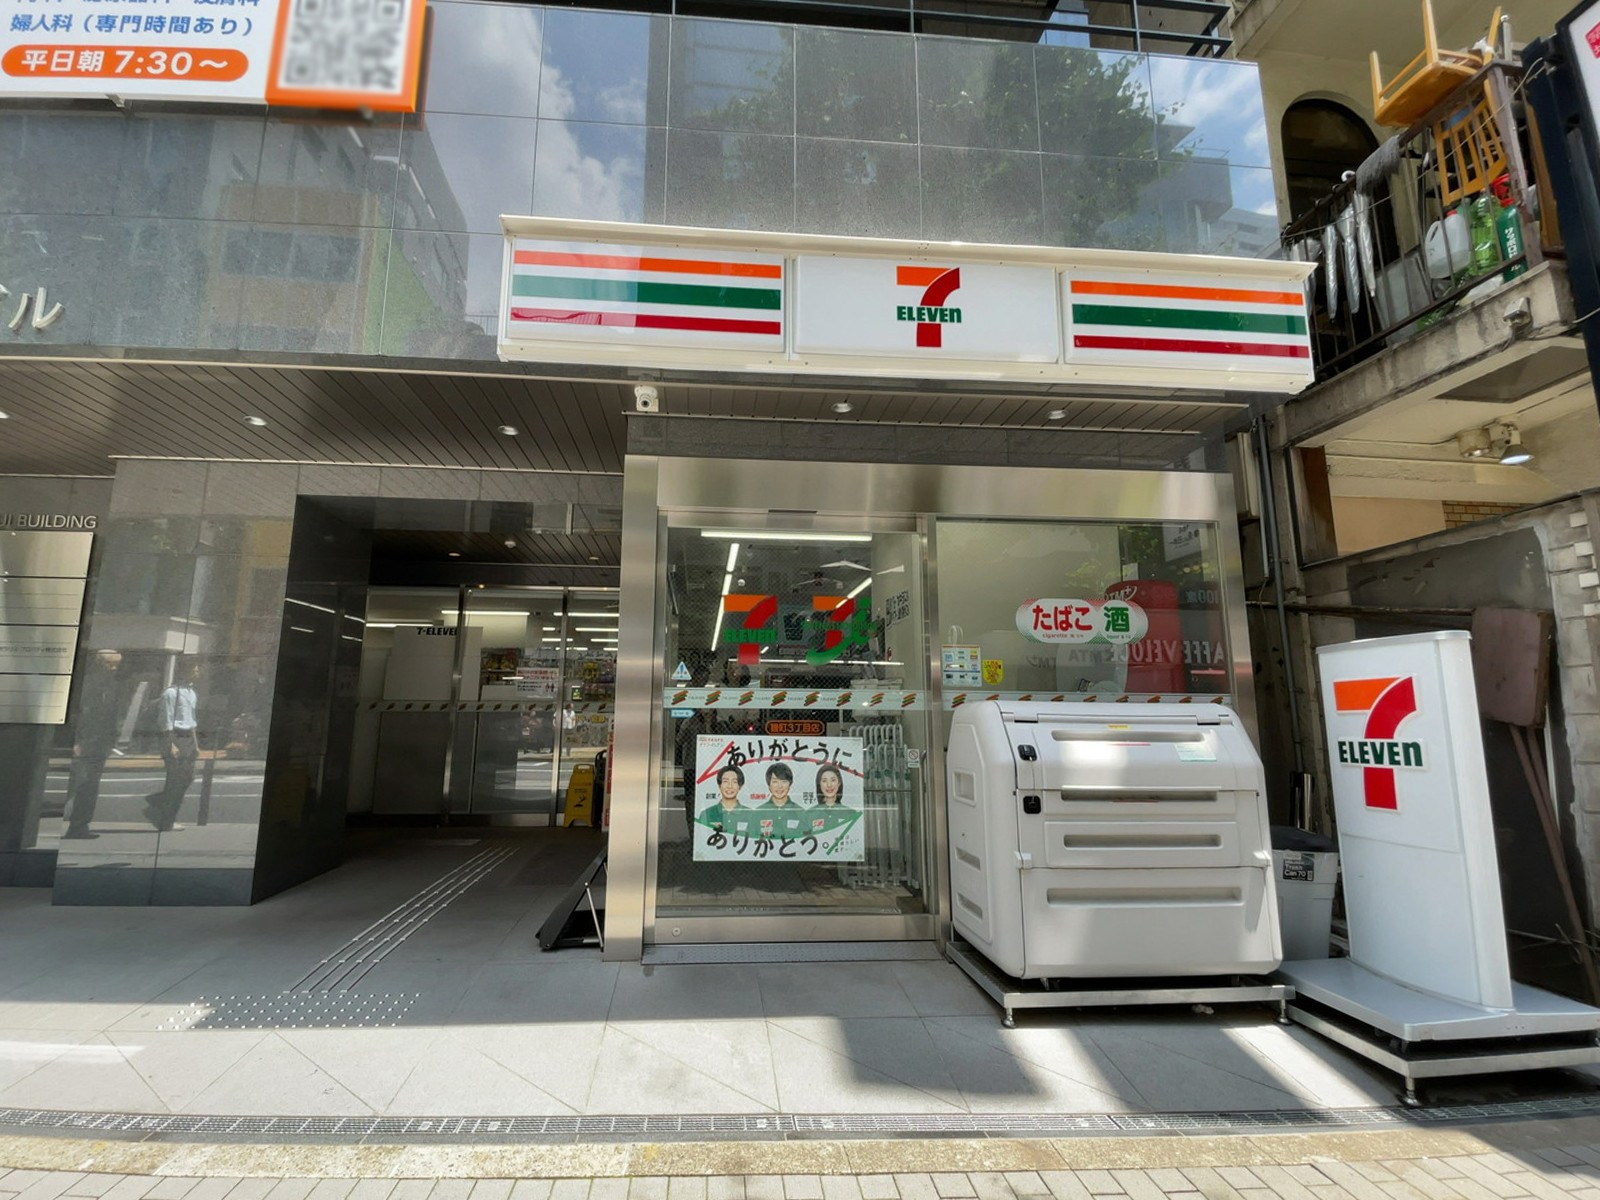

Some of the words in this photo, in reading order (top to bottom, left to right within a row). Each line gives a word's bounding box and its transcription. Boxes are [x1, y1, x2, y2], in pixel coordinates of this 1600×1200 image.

[21, 49, 104, 72] 平日朝
[0, 283, 64, 329] ル
[896, 265, 961, 348] 7
[18, 513, 97, 529] BUILDING
[1032, 604, 1093, 632] たばこ
[1103, 606, 1130, 632] 酒
[1333, 676, 1417, 810] 7
[707, 820, 829, 858] ありがとう。
